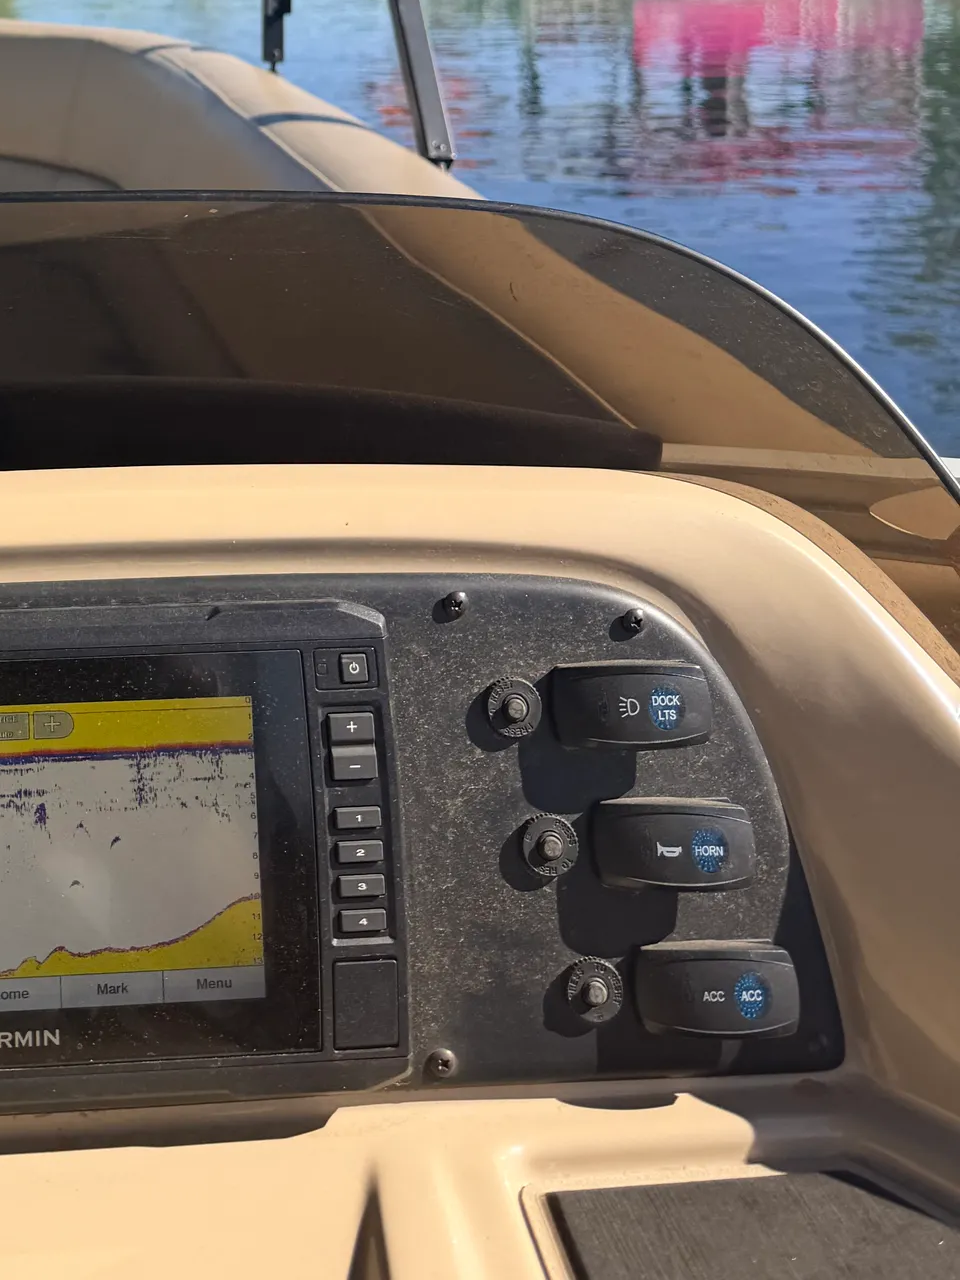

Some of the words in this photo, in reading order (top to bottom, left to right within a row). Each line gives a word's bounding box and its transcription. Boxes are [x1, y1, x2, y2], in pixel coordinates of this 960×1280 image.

[651, 695, 681, 706] DOCK
[658, 710, 677, 721] LTS
[356, 814, 362, 822] 1
[356, 848, 365, 856] 2
[695, 845, 724, 857] HORN
[358, 882, 367, 891] 3
[359, 918, 368, 926] 4
[97, 983, 129, 995] Mark
[196, 978, 233, 990] Menu
[703, 991, 725, 1002] ACC
[741, 990, 762, 1002] ACC
